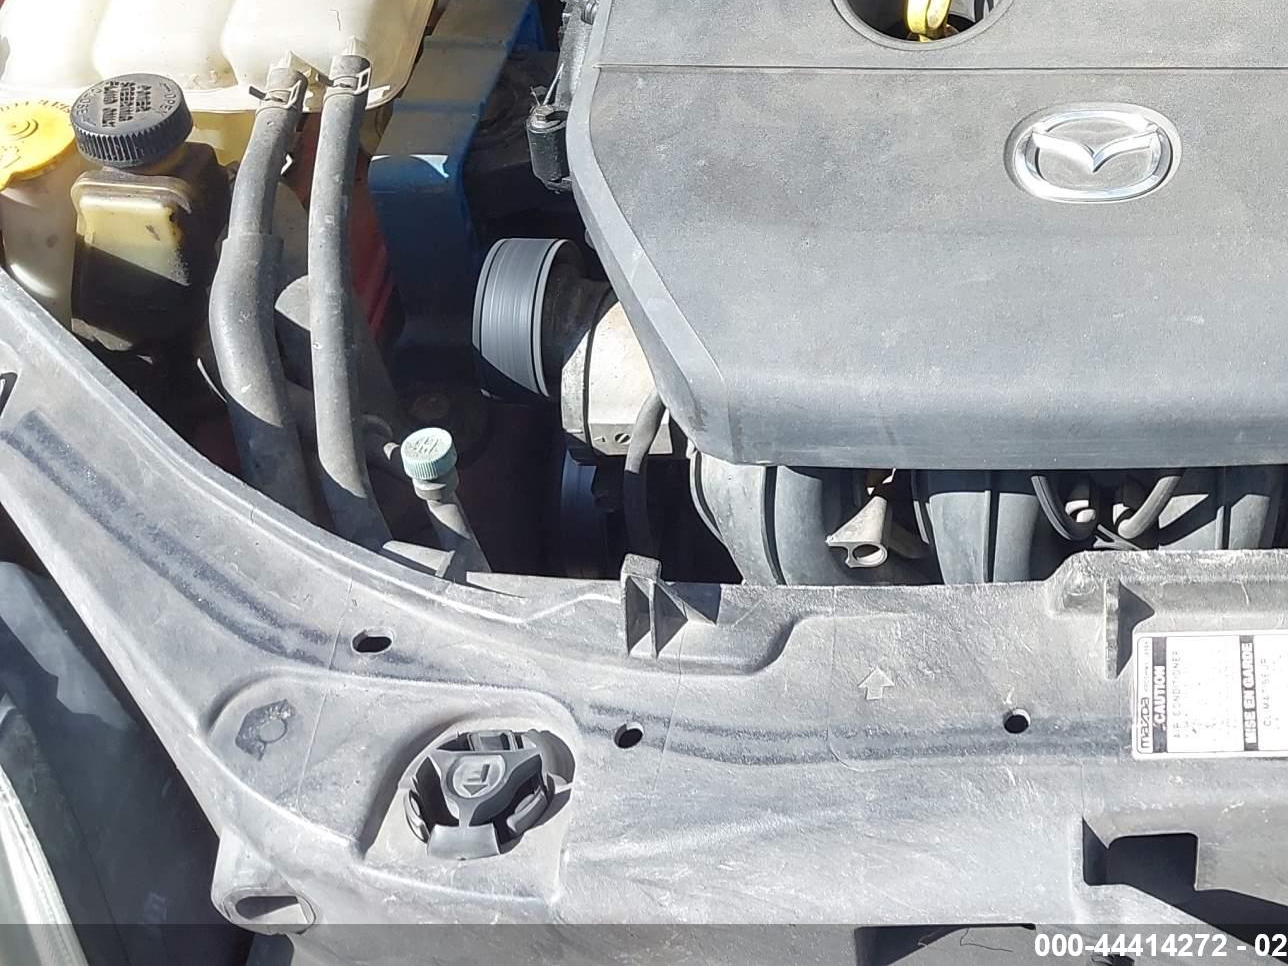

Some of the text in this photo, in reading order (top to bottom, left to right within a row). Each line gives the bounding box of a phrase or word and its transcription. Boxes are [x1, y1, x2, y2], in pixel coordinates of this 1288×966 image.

[1154, 665, 1166, 724] CAUTION
[1241, 642, 1257, 743] MISE EN GARDE
